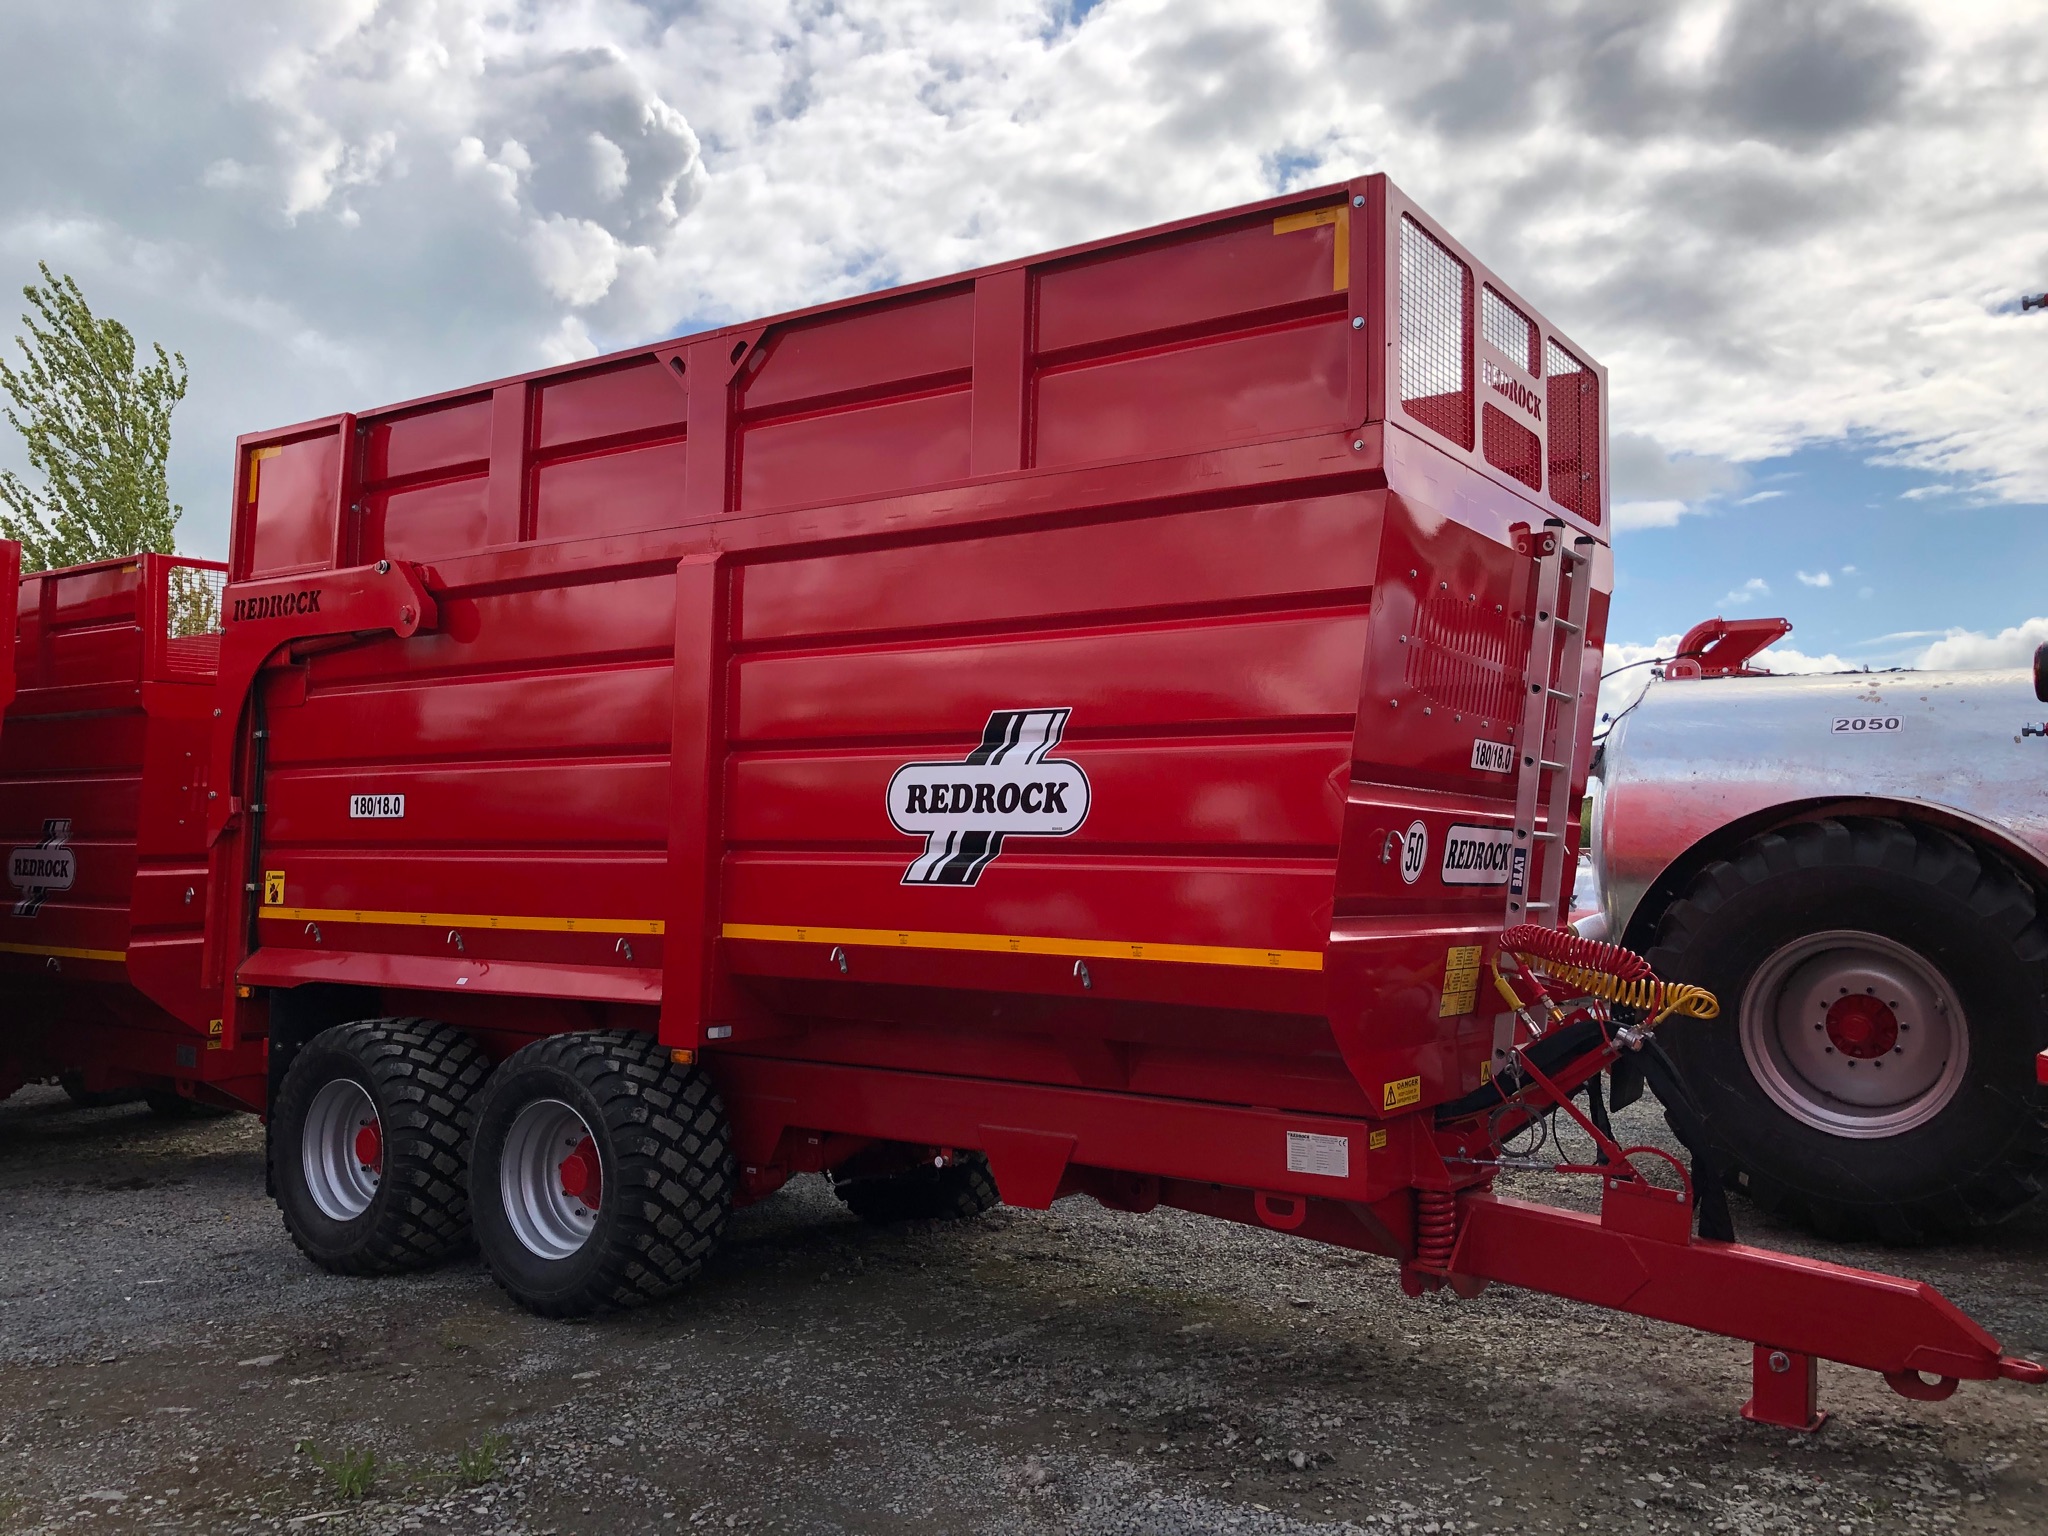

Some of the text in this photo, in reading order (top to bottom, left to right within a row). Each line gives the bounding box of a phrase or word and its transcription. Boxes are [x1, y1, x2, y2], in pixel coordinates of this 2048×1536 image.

[1482, 357, 1541, 421] REDROCK
[233, 590, 321, 622] REDROCK
[1835, 718, 1899, 731] 2050
[1475, 742, 1512, 770] 180/18.0
[353, 796, 401, 816] 180/18.0
[905, 782, 1069, 814] REDROCK
[1405, 832, 1424, 871] 50
[1445, 839, 1512, 870] REDROCK
[13, 857, 69, 878] REDROCK
[1512, 856, 1525, 888] LYTE
[1397, 1078, 1418, 1090] DANGER
